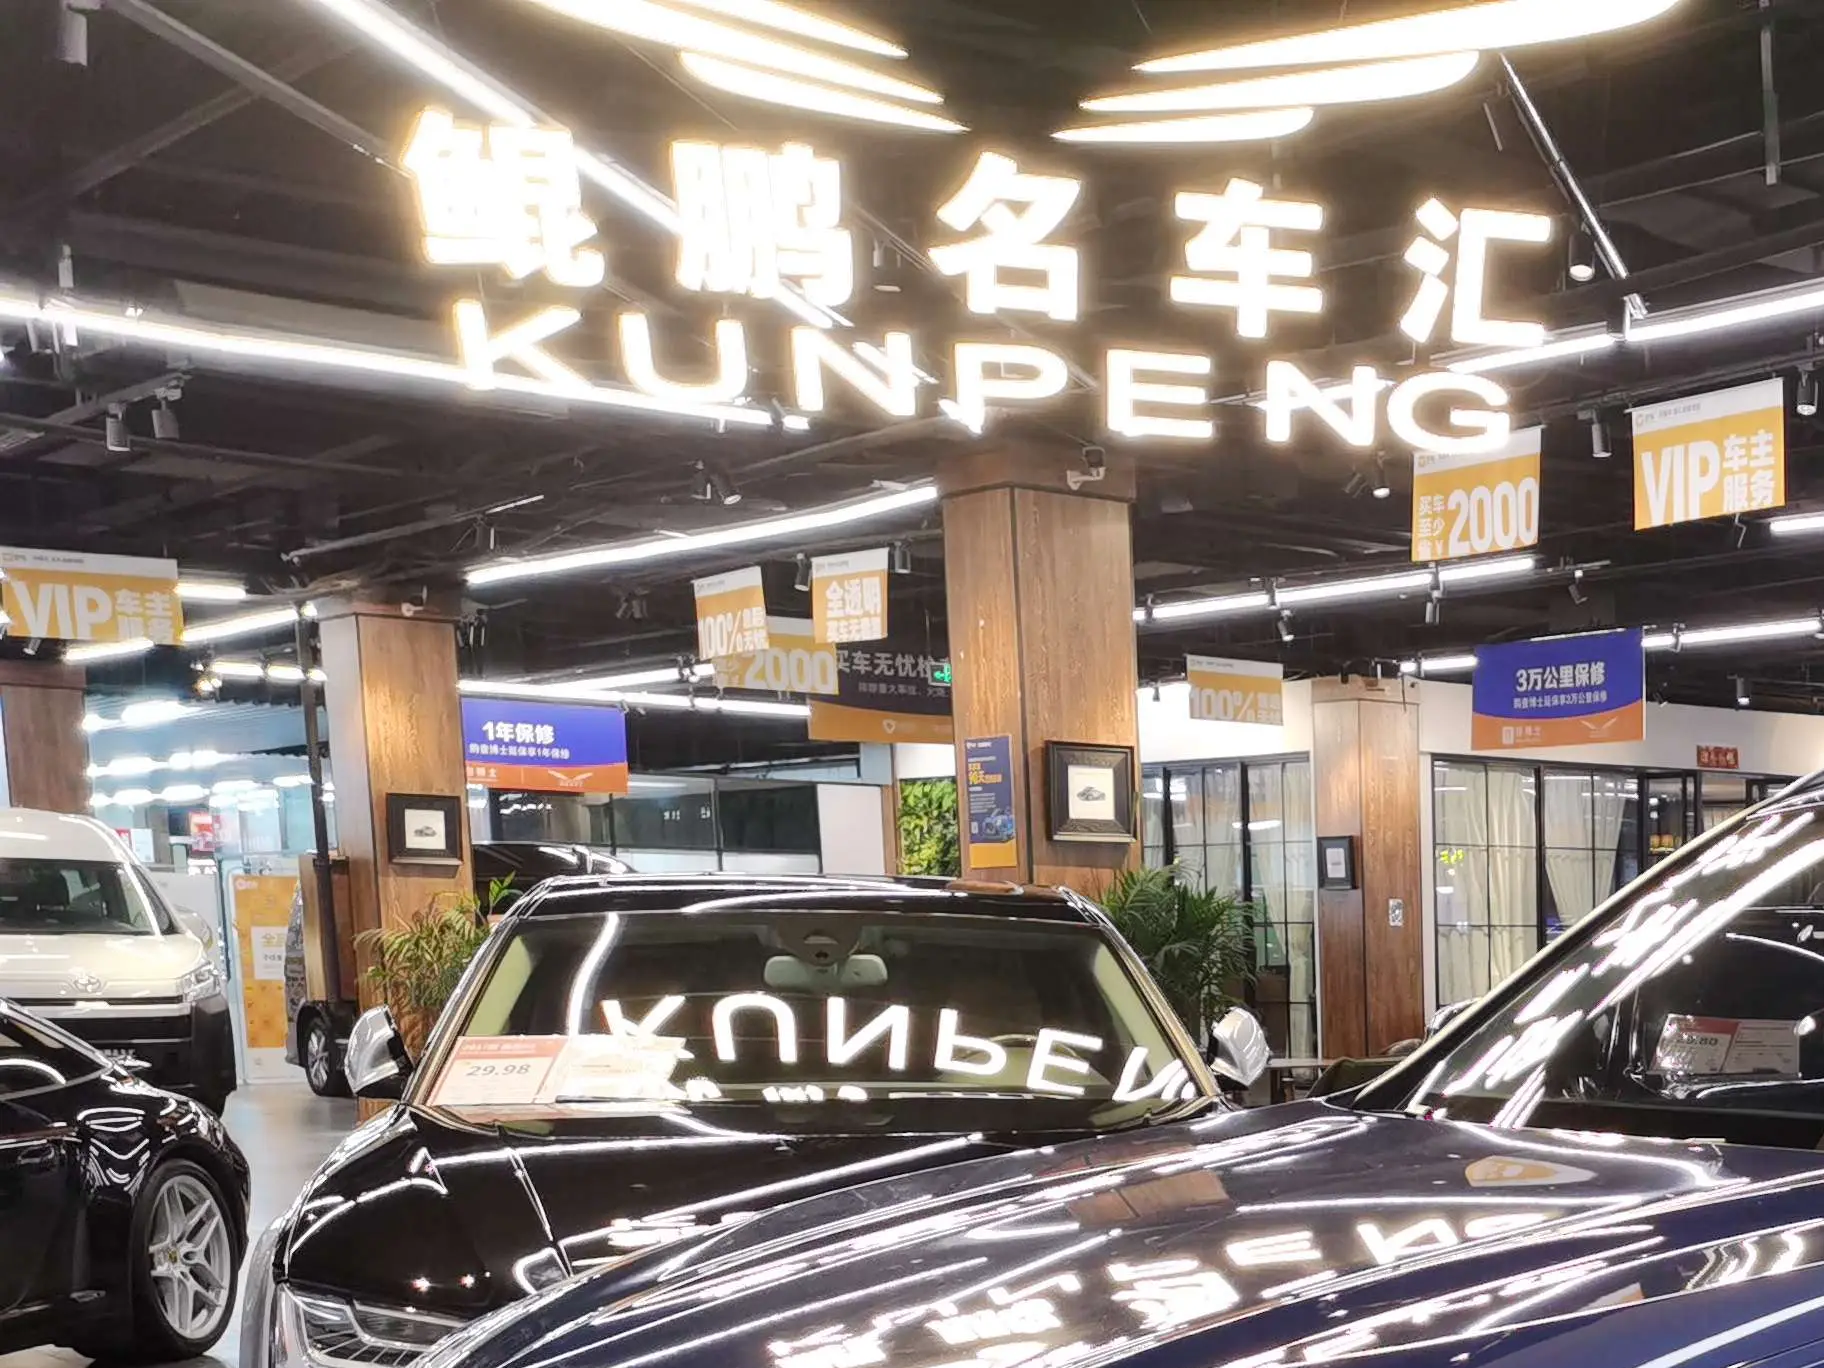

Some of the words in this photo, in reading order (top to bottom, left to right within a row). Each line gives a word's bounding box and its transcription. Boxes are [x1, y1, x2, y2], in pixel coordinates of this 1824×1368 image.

[453, 298, 1511, 454] KUNPENG
[1723, 429, 1775, 470] 车主
[1641, 440, 1720, 527] VIP
[1723, 469, 1775, 513] 服务
[1447, 476, 1538, 558] 2000
[12, 580, 112, 640] VIP
[114, 588, 173, 617] 车主
[1516, 661, 1605, 692] 3万公里保修
[482, 720, 554, 745] 1年保修
[467, 1063, 531, 1077] 29.98
